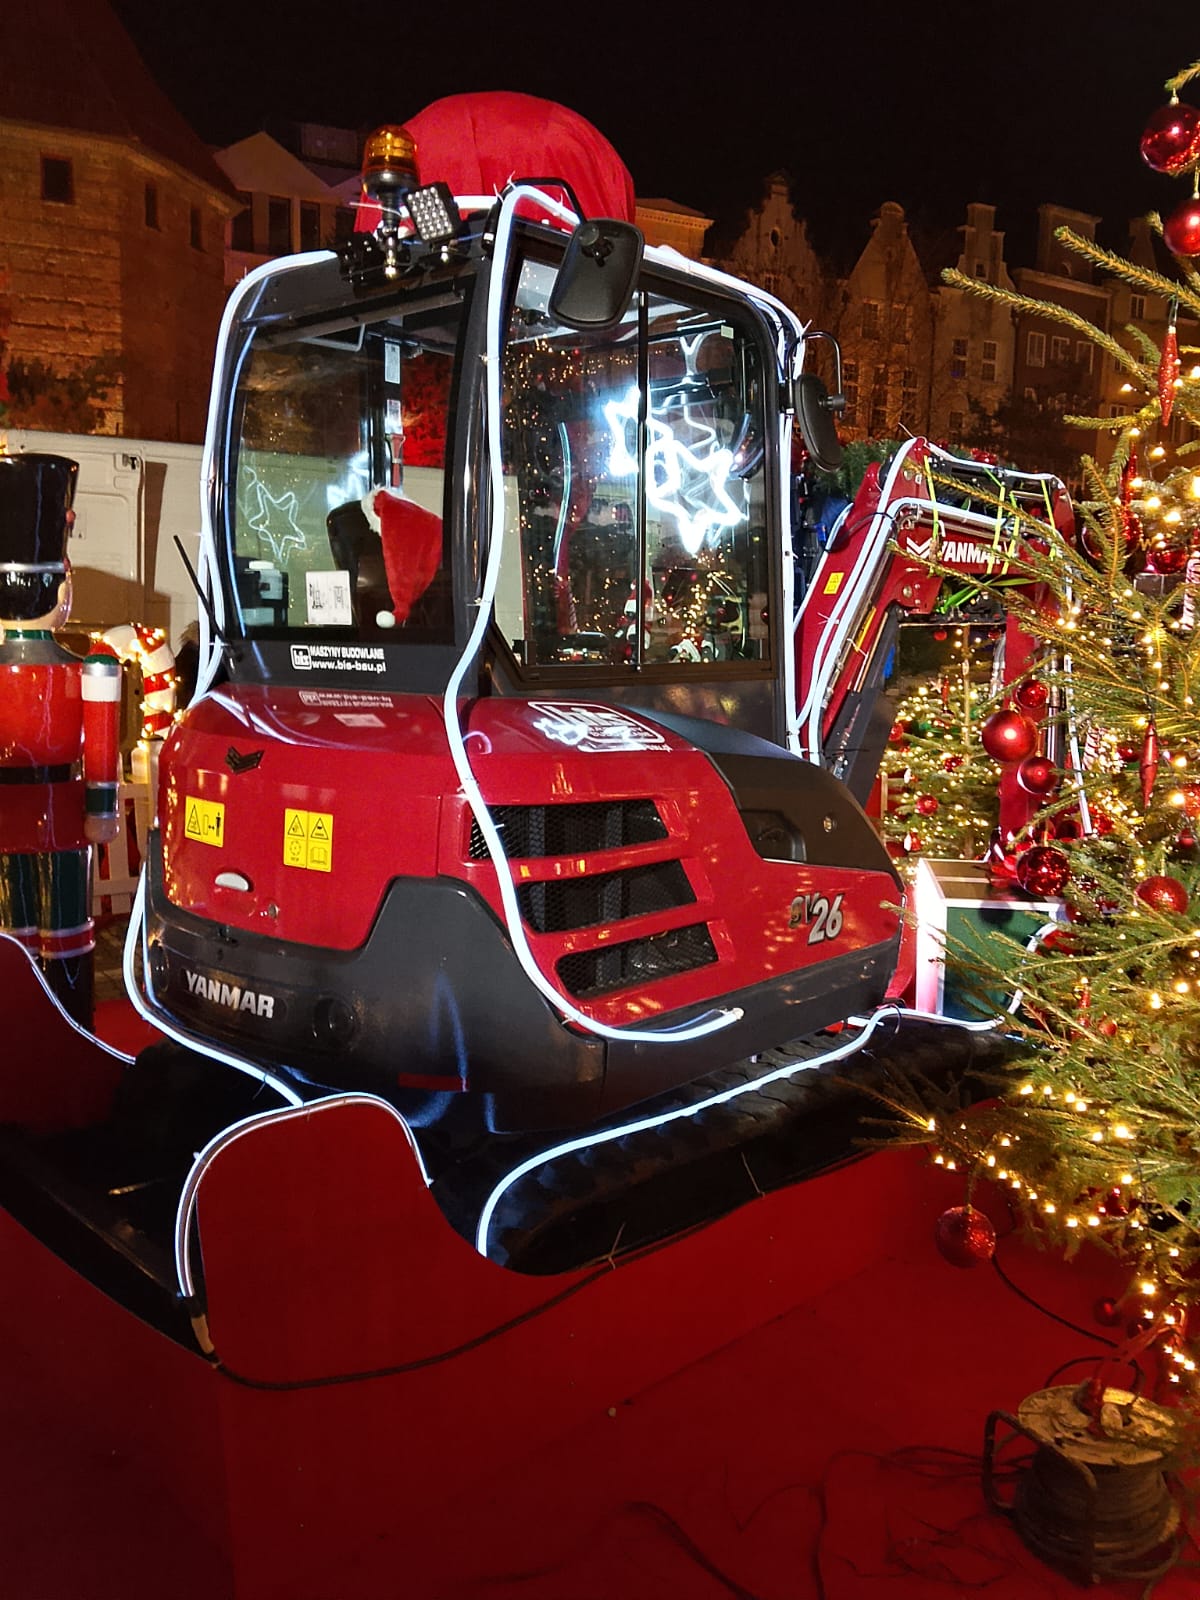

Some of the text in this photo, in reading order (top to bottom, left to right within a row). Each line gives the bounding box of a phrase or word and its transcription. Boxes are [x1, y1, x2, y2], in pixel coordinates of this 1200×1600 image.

[309, 645, 385, 660] MASZYNY BUDOWLANE
[185, 969, 275, 1019] YANMAR
